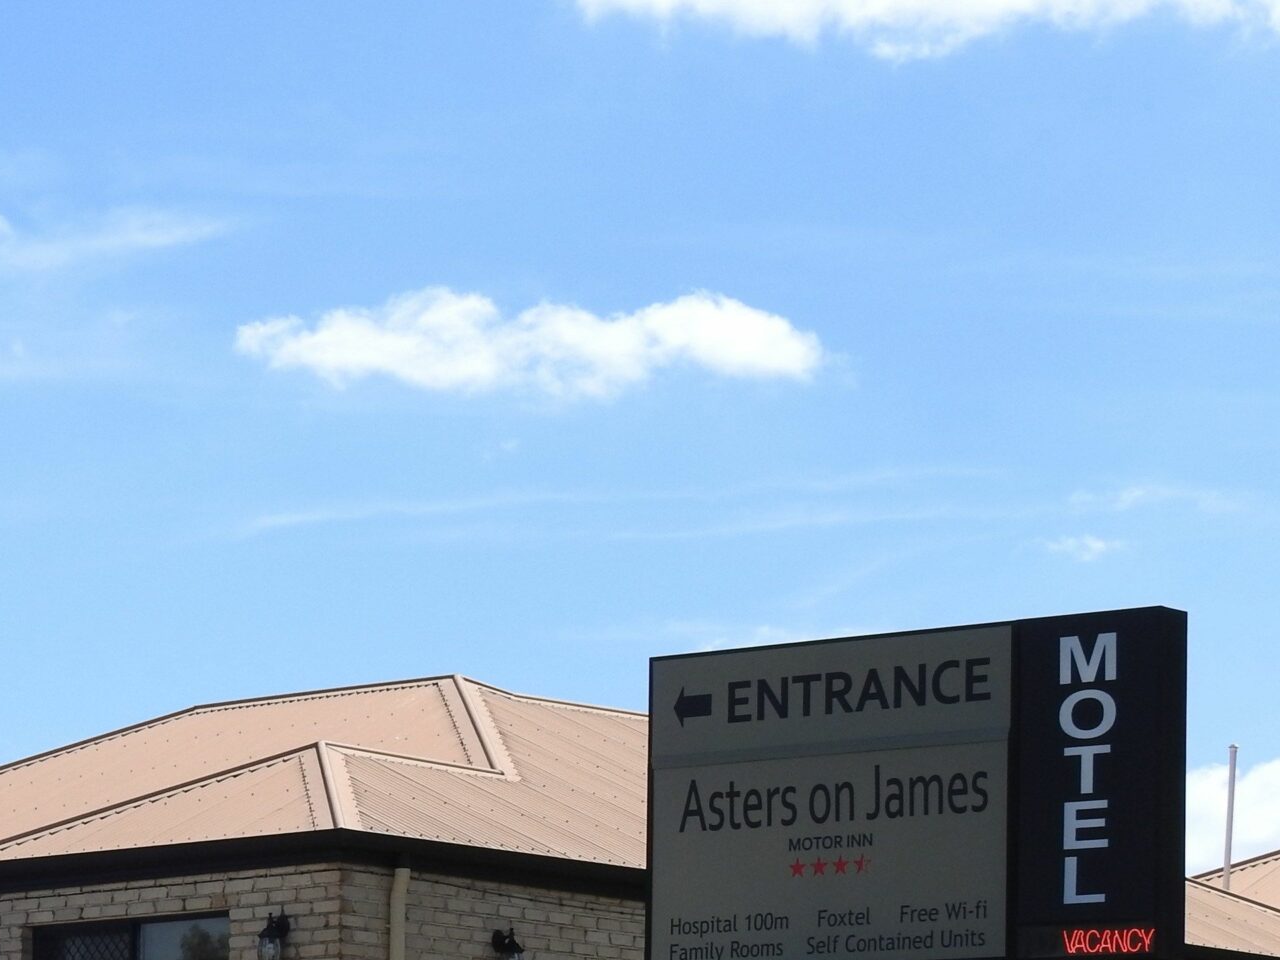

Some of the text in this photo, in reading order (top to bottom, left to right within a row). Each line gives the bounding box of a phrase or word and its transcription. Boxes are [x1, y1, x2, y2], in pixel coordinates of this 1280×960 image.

[727, 657, 992, 724] ENTRANCE
[1059, 632, 1117, 904] MOTEL
[679, 764, 989, 833] Asters on James
[788, 833, 873, 852] MOTOR INN
[670, 900, 988, 938] Hospital 100m Foxtel Free Wi-fi
[730, 941, 784, 959] Rooms
[806, 935, 840, 954] Self
[845, 930, 933, 953] Contained
[941, 928, 986, 948] Units
[1063, 928, 1155, 955] VACANCY
